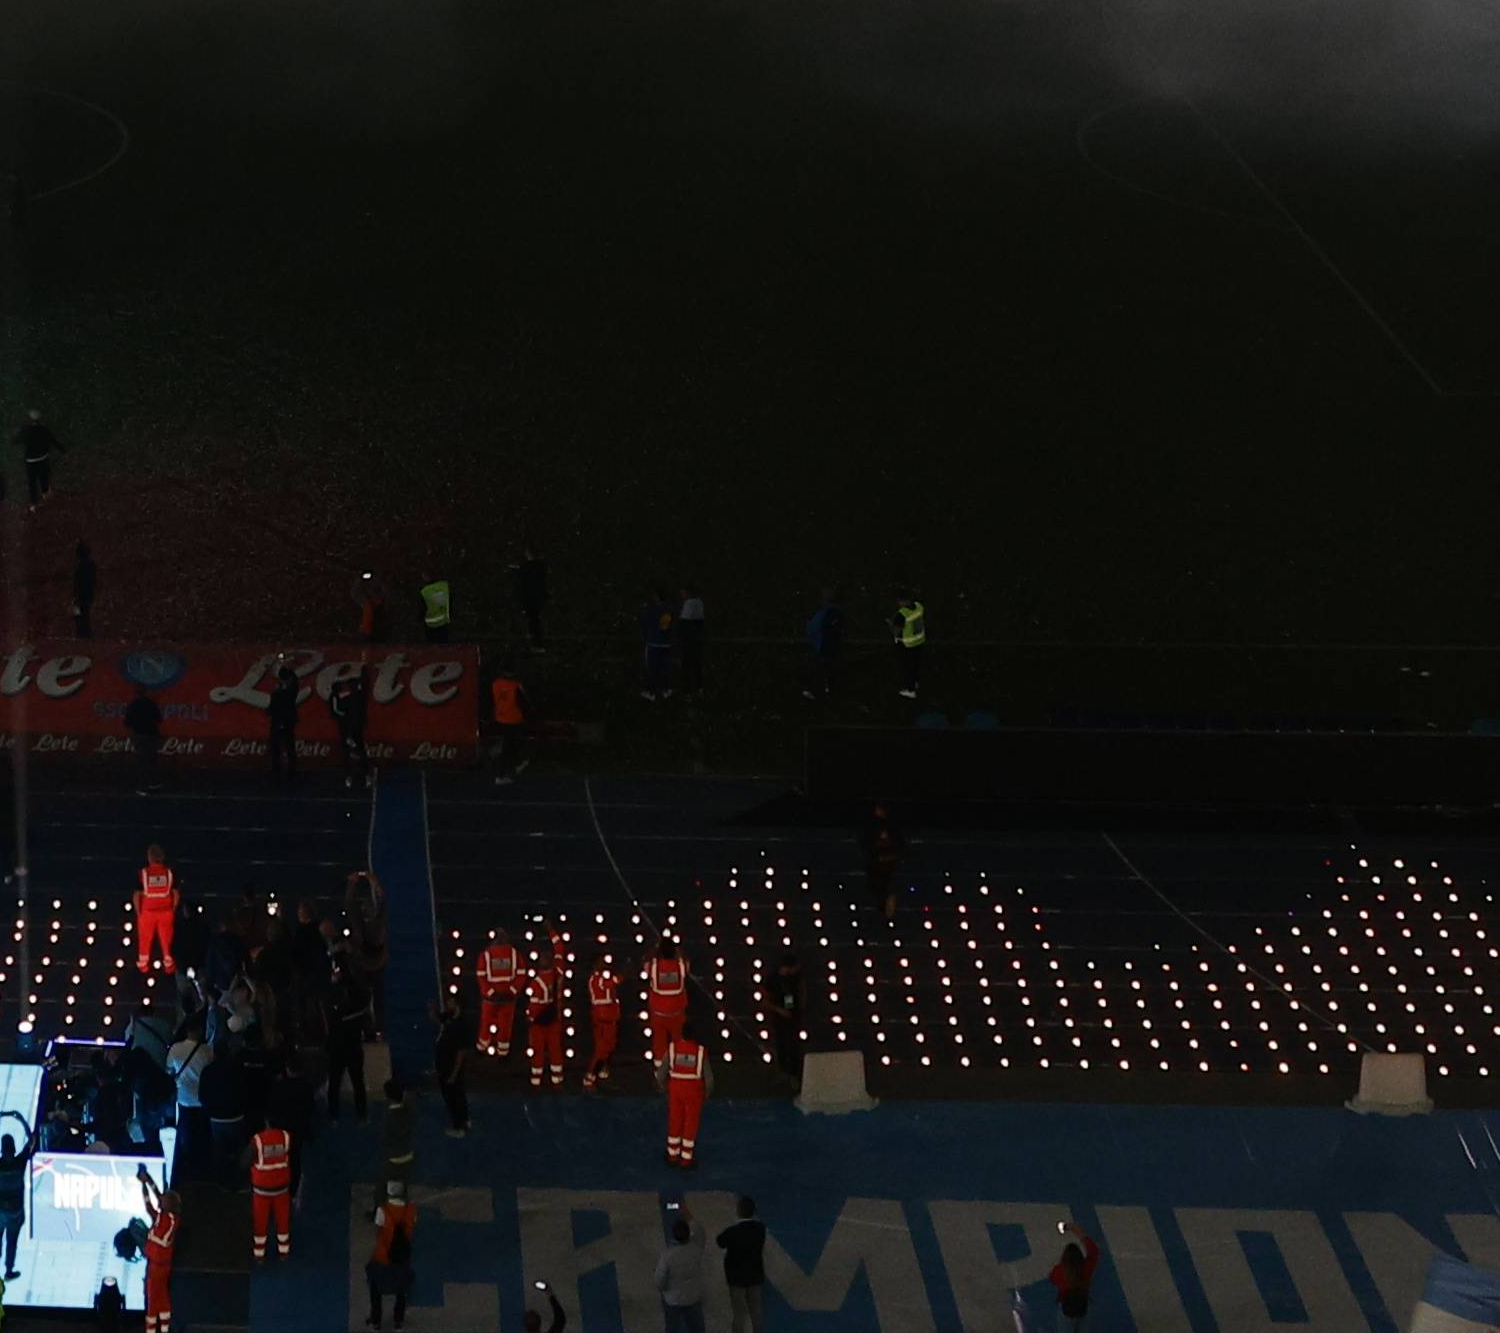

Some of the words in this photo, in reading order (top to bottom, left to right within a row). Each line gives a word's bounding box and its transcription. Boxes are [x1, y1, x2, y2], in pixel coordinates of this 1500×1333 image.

[32, 735, 79, 753] Lete
[157, 738, 204, 757] Lete
[220, 738, 268, 757] Lete
[409, 741, 458, 761] Lete
